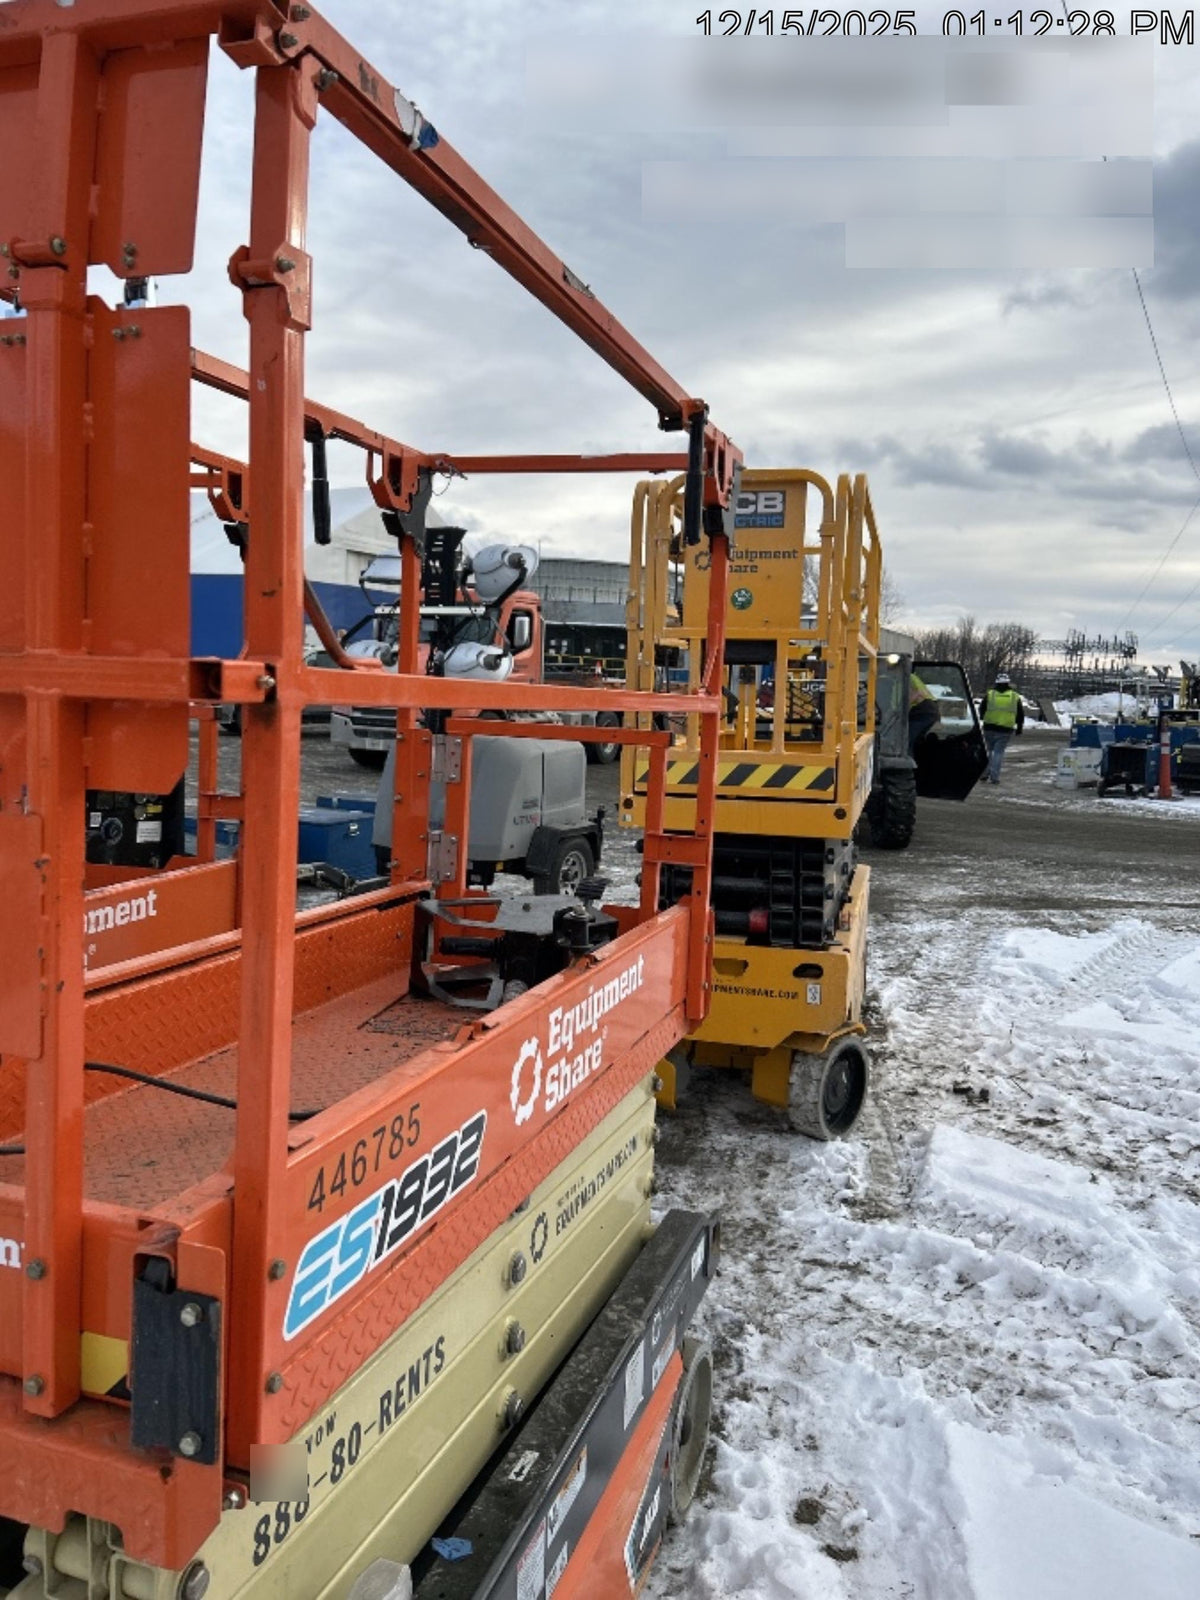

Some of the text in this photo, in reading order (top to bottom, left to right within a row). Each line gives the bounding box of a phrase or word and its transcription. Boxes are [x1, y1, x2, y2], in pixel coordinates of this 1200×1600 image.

[736, 492, 783, 514] CB
[86, 889, 158, 935] ment
[547, 954, 644, 1058] Equipment
[545, 1036, 604, 1113] Share
[307, 1103, 420, 1213] 446785
[284, 1109, 487, 1341] ES1932
